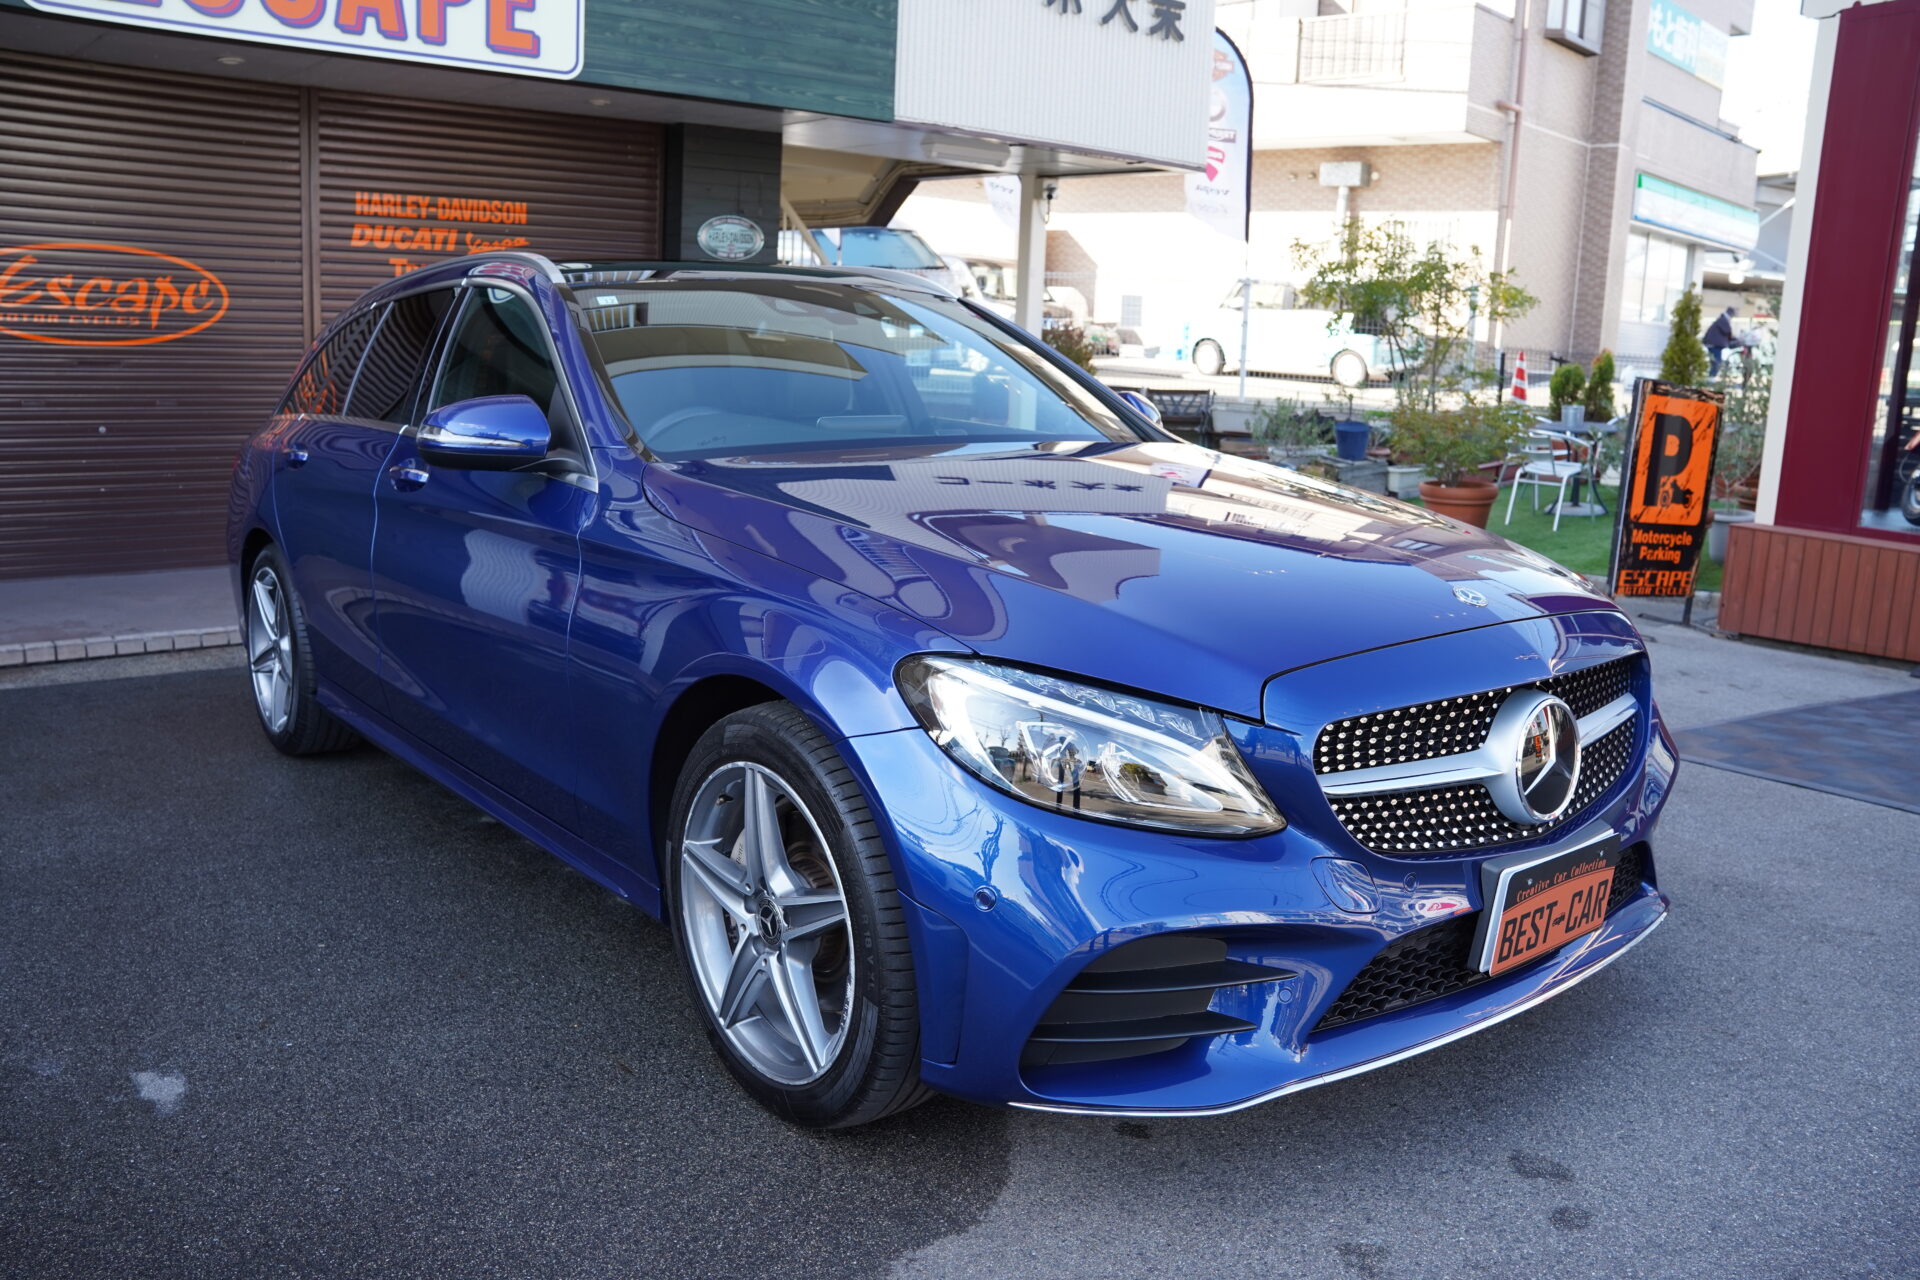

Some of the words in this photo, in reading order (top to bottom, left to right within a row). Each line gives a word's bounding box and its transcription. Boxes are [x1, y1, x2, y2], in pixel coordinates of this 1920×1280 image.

[355, 191, 528, 225] HARLEY-DAVIDSON
[350, 223, 458, 251] DUCATI
[0, 254, 214, 329] Escape
[68, 315, 141, 326] CYCLES
[1644, 413, 1693, 506] P
[1632, 528, 1693, 547] Motorcycle
[1639, 546, 1682, 565] Parking
[1619, 569, 1693, 588] ESCAPE
[1516, 879, 1550, 903] Creative
[1553, 871, 1568, 884] Car
[1570, 858, 1607, 876] Collection
